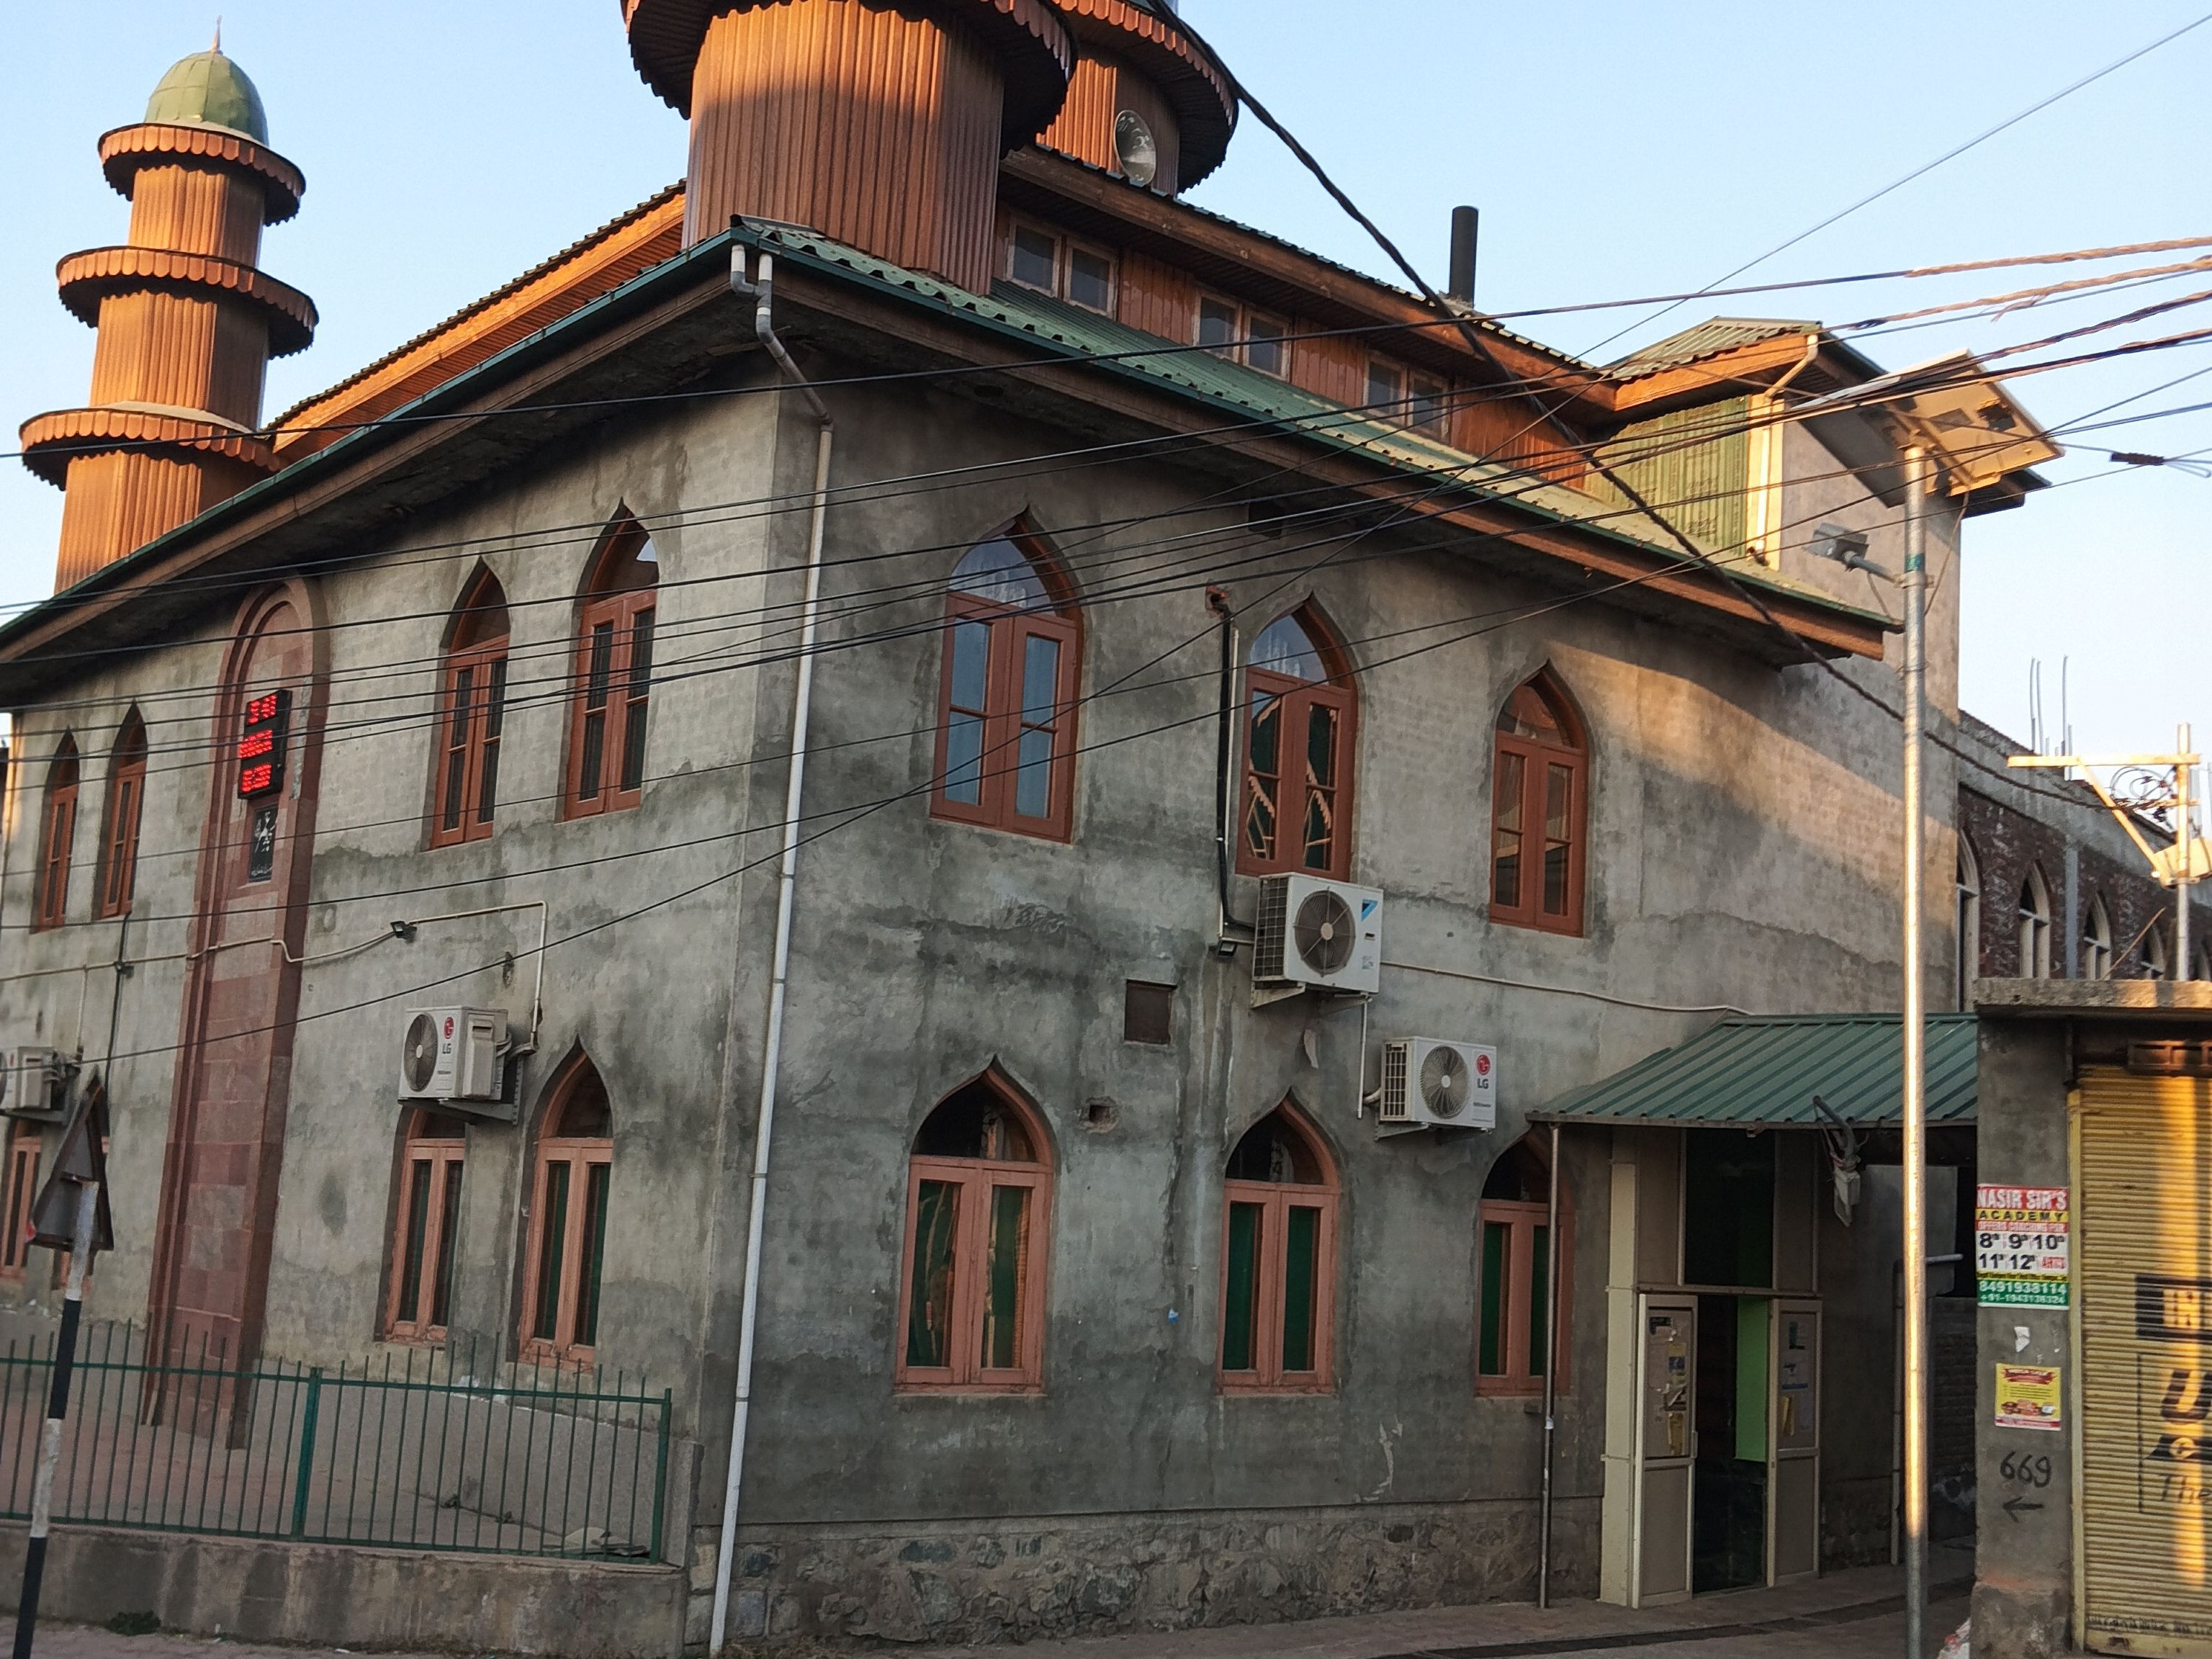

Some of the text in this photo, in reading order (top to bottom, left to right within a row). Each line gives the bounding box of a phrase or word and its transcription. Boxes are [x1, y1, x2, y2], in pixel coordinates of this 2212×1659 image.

[442, 1043, 451, 1054] LG
[1477, 1078, 1489, 1089] LG
[1977, 1189, 2067, 1210] NASIR SIR'S
[1979, 1210, 2064, 1220] ACADEMY
[2000, 1451, 2051, 1488] 669
